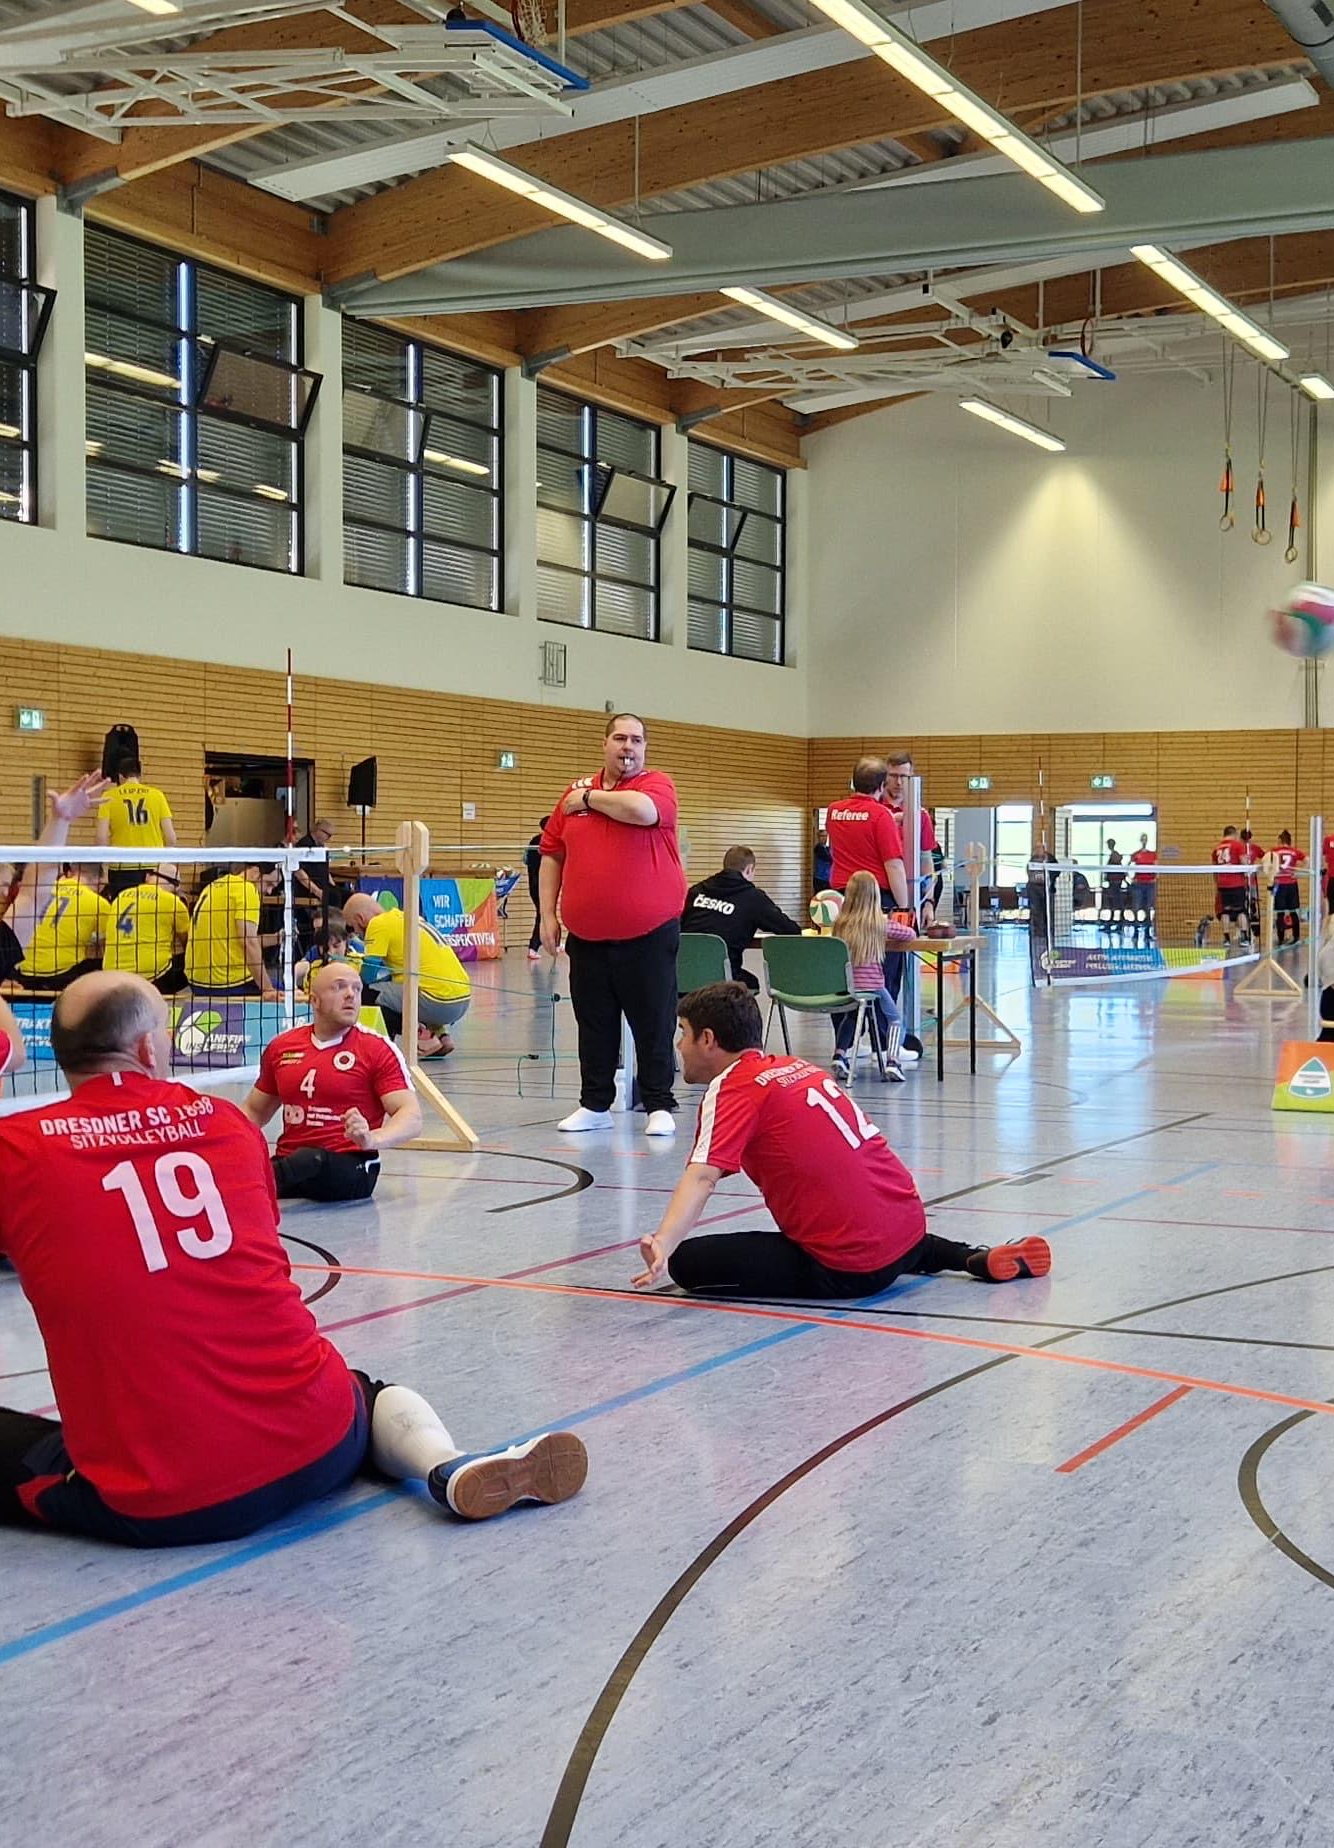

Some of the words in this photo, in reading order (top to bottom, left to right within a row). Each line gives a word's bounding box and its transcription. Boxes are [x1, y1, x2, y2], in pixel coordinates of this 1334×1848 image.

[123, 798, 149, 826] 16
[831, 809, 869, 821] Referee
[432, 895, 450, 909] WIR
[693, 894, 735, 915] ČESKO
[434, 913, 476, 928] SCHAFFEN
[300, 1069, 317, 1099] 4
[40, 1110, 143, 1136] DRESDNER
[146, 1106, 171, 1125] SC
[175, 1096, 214, 1121] 1898
[70, 1119, 206, 1150] SITZVOLLEYBALL
[101, 1151, 233, 1273] 19
